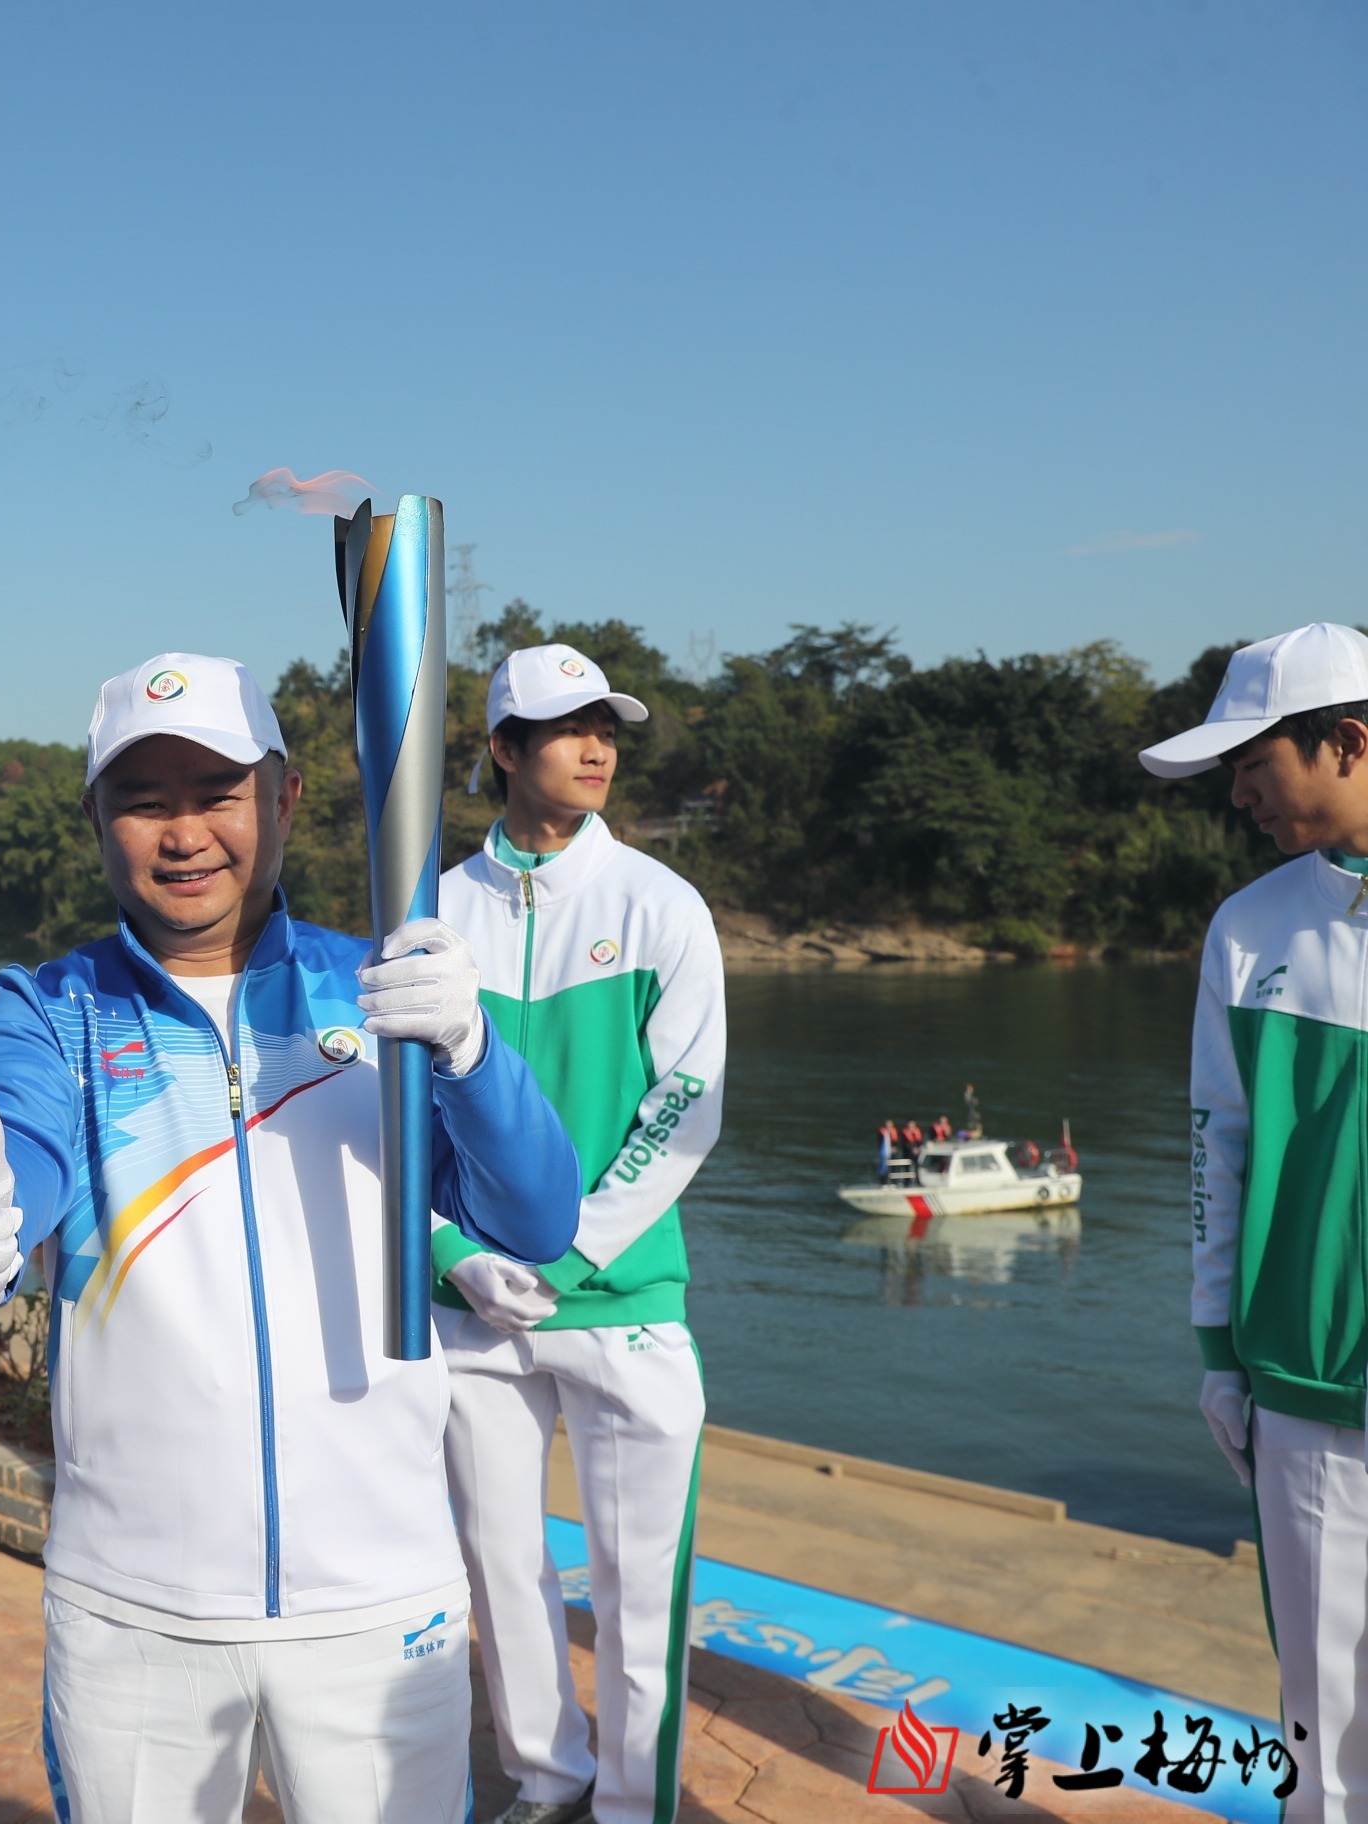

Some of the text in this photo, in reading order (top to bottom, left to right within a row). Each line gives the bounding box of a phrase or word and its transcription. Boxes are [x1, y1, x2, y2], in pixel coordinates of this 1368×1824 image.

[614, 1070, 707, 1185] Passion
[1191, 1107, 1213, 1244] Passion
[403, 1638, 447, 1661] 跃速体育
